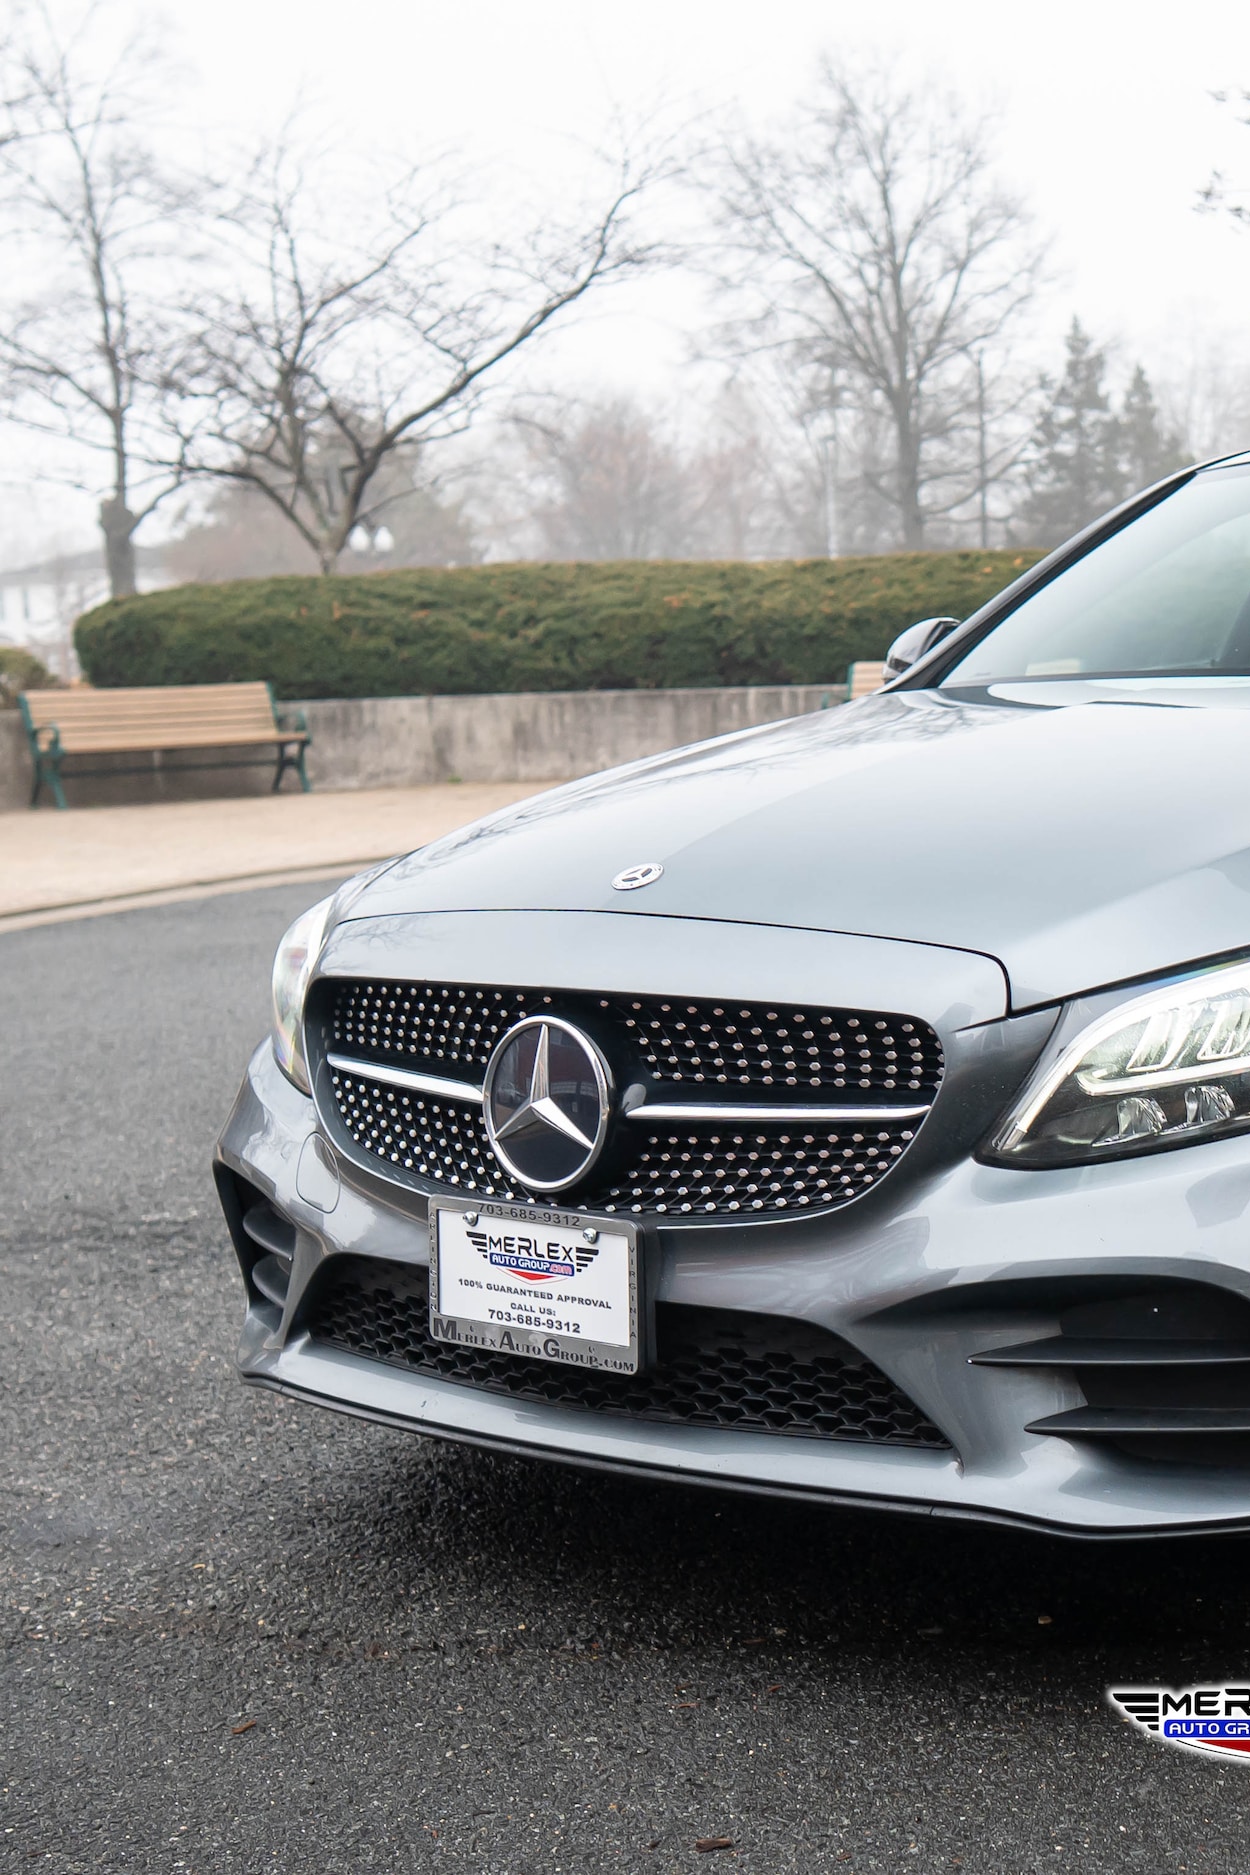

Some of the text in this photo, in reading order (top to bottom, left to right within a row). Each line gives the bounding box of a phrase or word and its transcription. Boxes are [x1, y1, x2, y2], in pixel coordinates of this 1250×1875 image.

[479, 1203, 580, 1227] 703-685-9312
[489, 1235, 574, 1263] MERLEX
[492, 1255, 517, 1267] AUTO
[458, 1278, 612, 1310] 100% GUARANTEED APPROVAL
[628, 1246, 637, 1339] VIRGINIA
[488, 1308, 581, 1334] 703-685-9312
[510, 1302, 556, 1316] CALL US:
